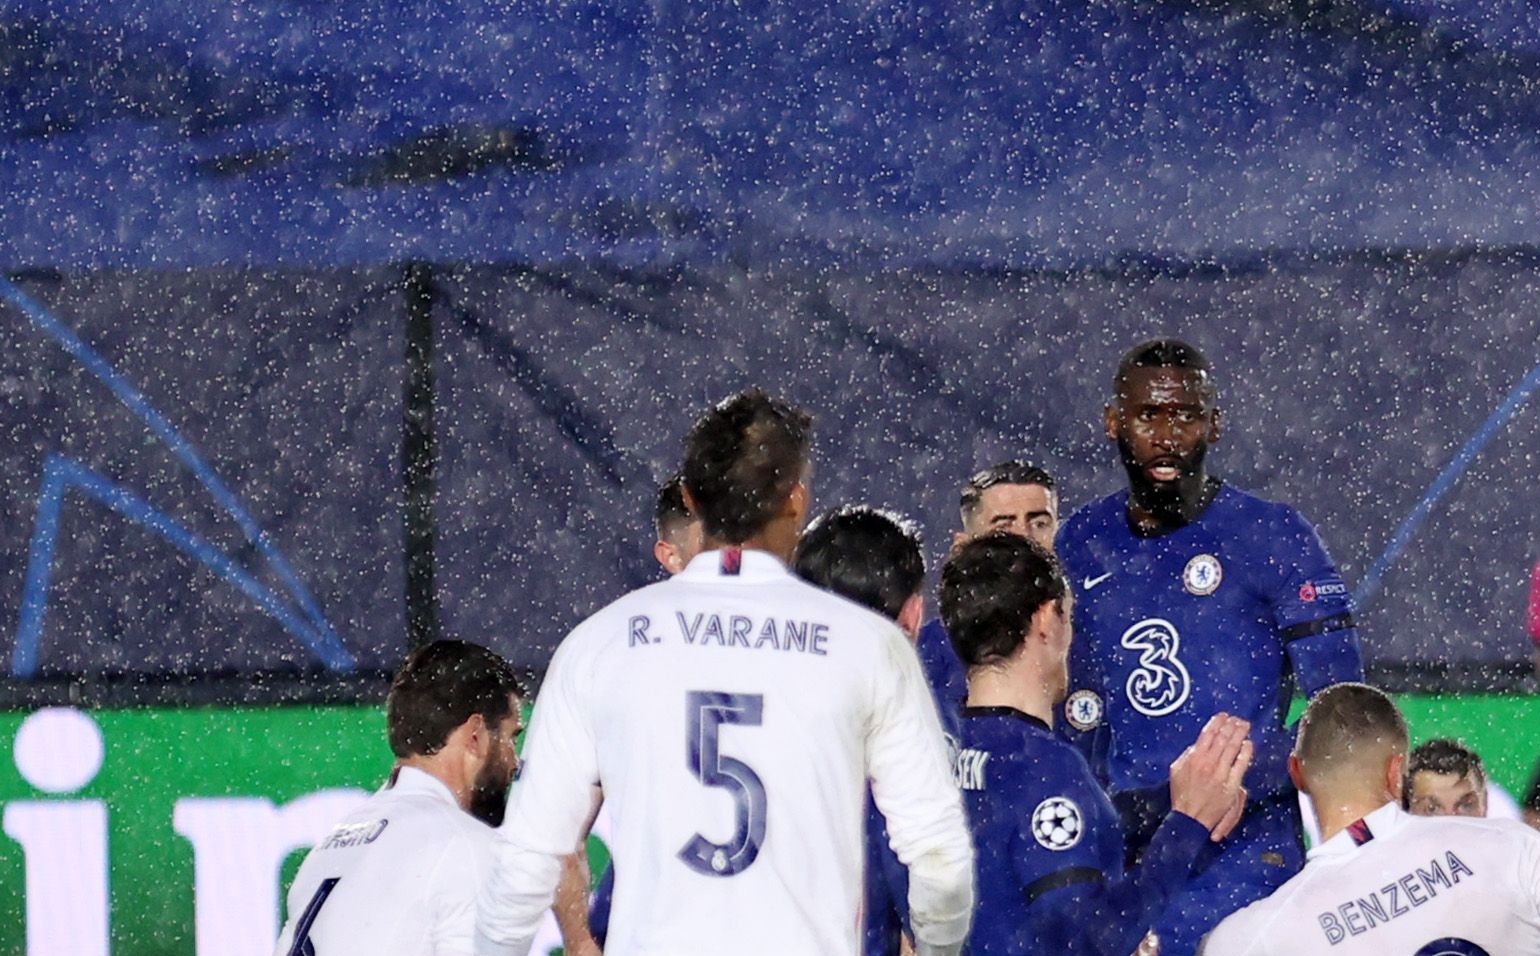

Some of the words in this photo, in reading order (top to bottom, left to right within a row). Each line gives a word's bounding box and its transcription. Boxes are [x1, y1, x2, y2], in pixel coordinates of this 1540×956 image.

[628, 614, 662, 648] R.
[676, 611, 830, 656] VARANE
[1121, 618, 1191, 716] 3
[676, 691, 768, 877] 5
[1319, 850, 1474, 946] BENZEMA
